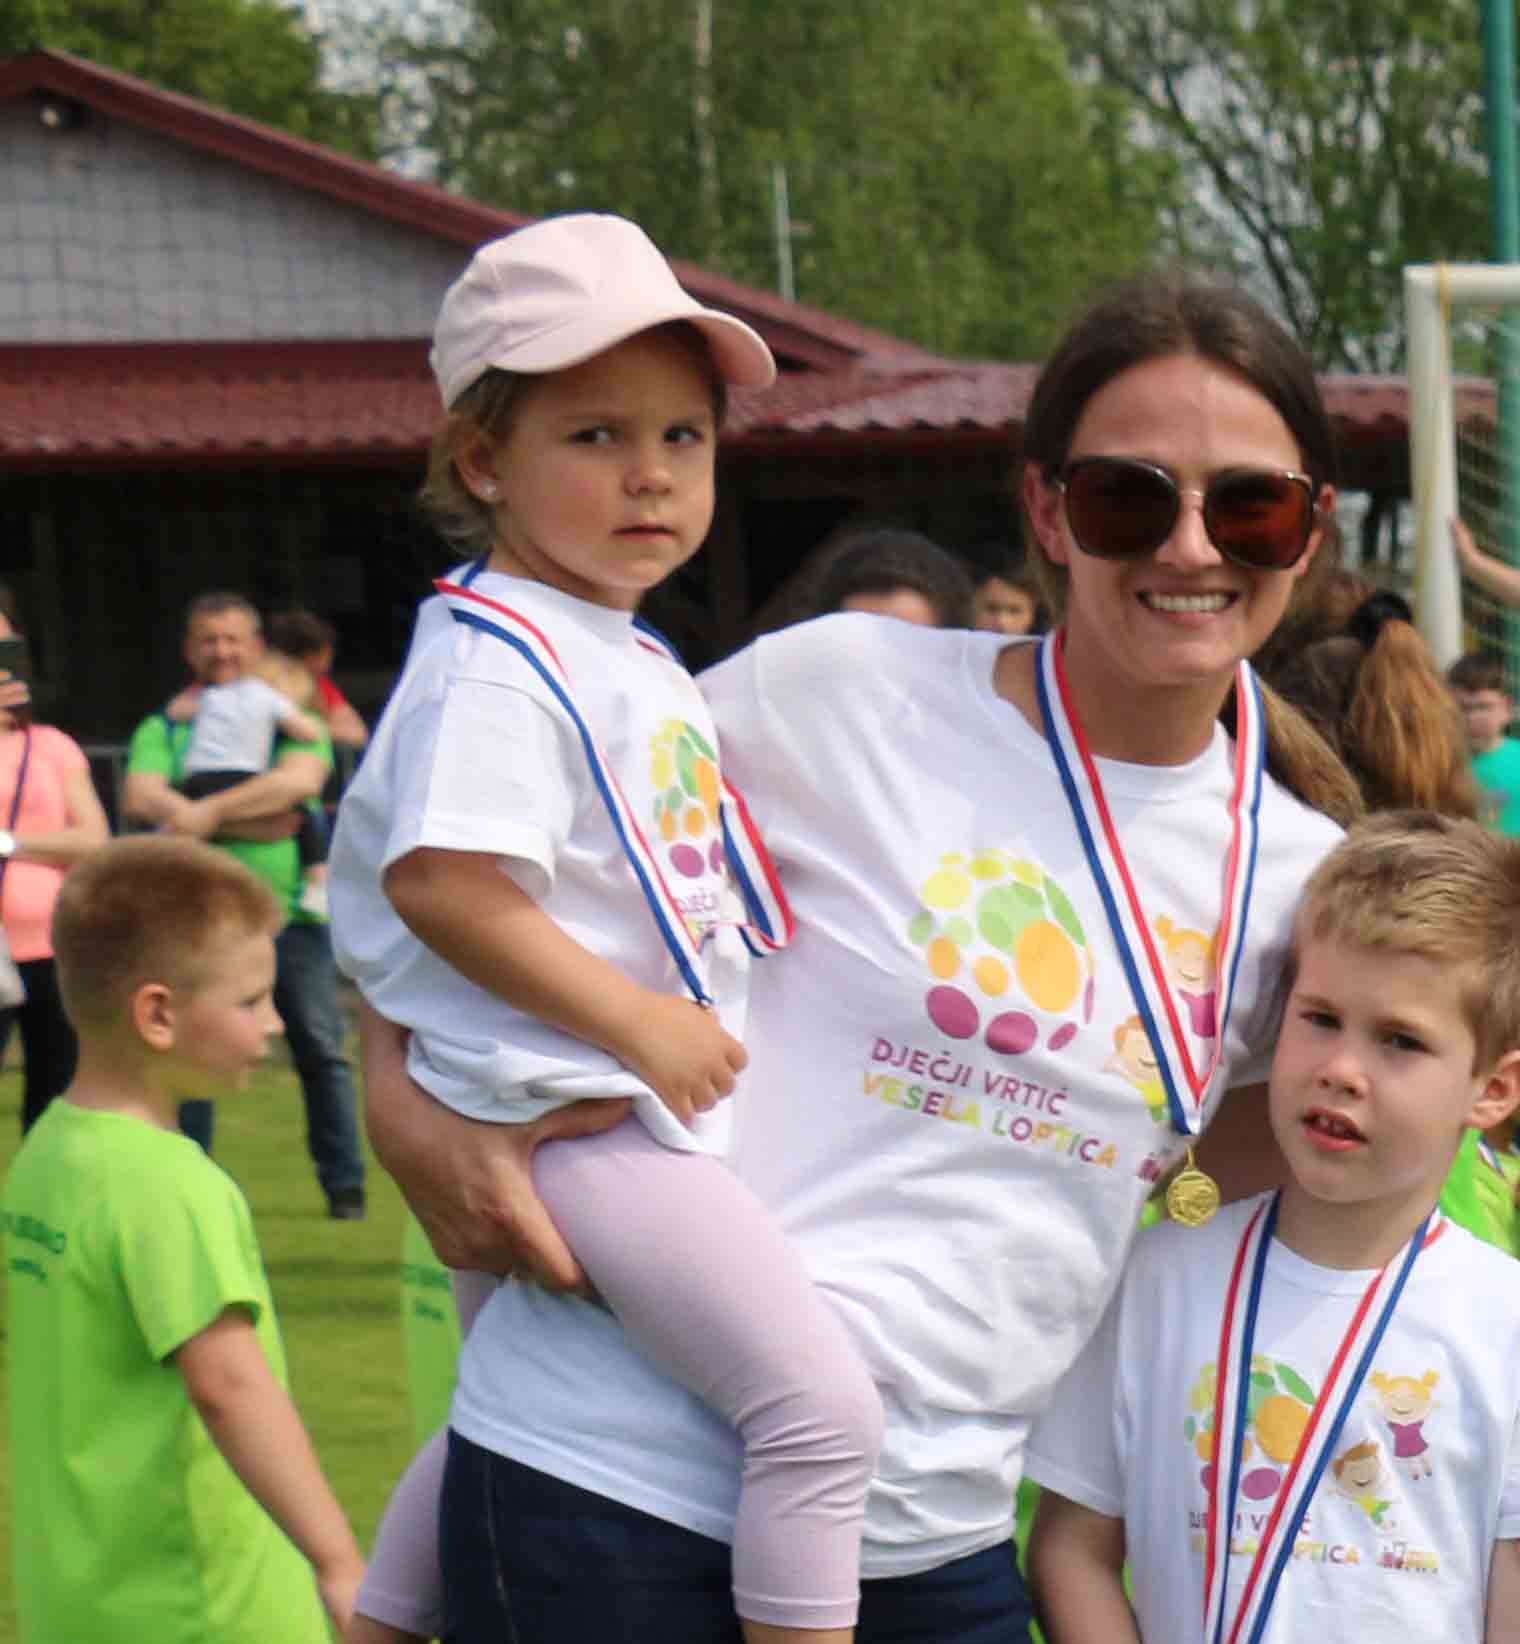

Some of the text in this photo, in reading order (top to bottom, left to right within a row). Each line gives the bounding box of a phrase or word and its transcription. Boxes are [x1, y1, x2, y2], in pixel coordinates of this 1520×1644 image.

[863, 1071, 1119, 1168] VESELA LOPTICA
[871, 1037, 1069, 1115] DJEČJI VRTIĆ
